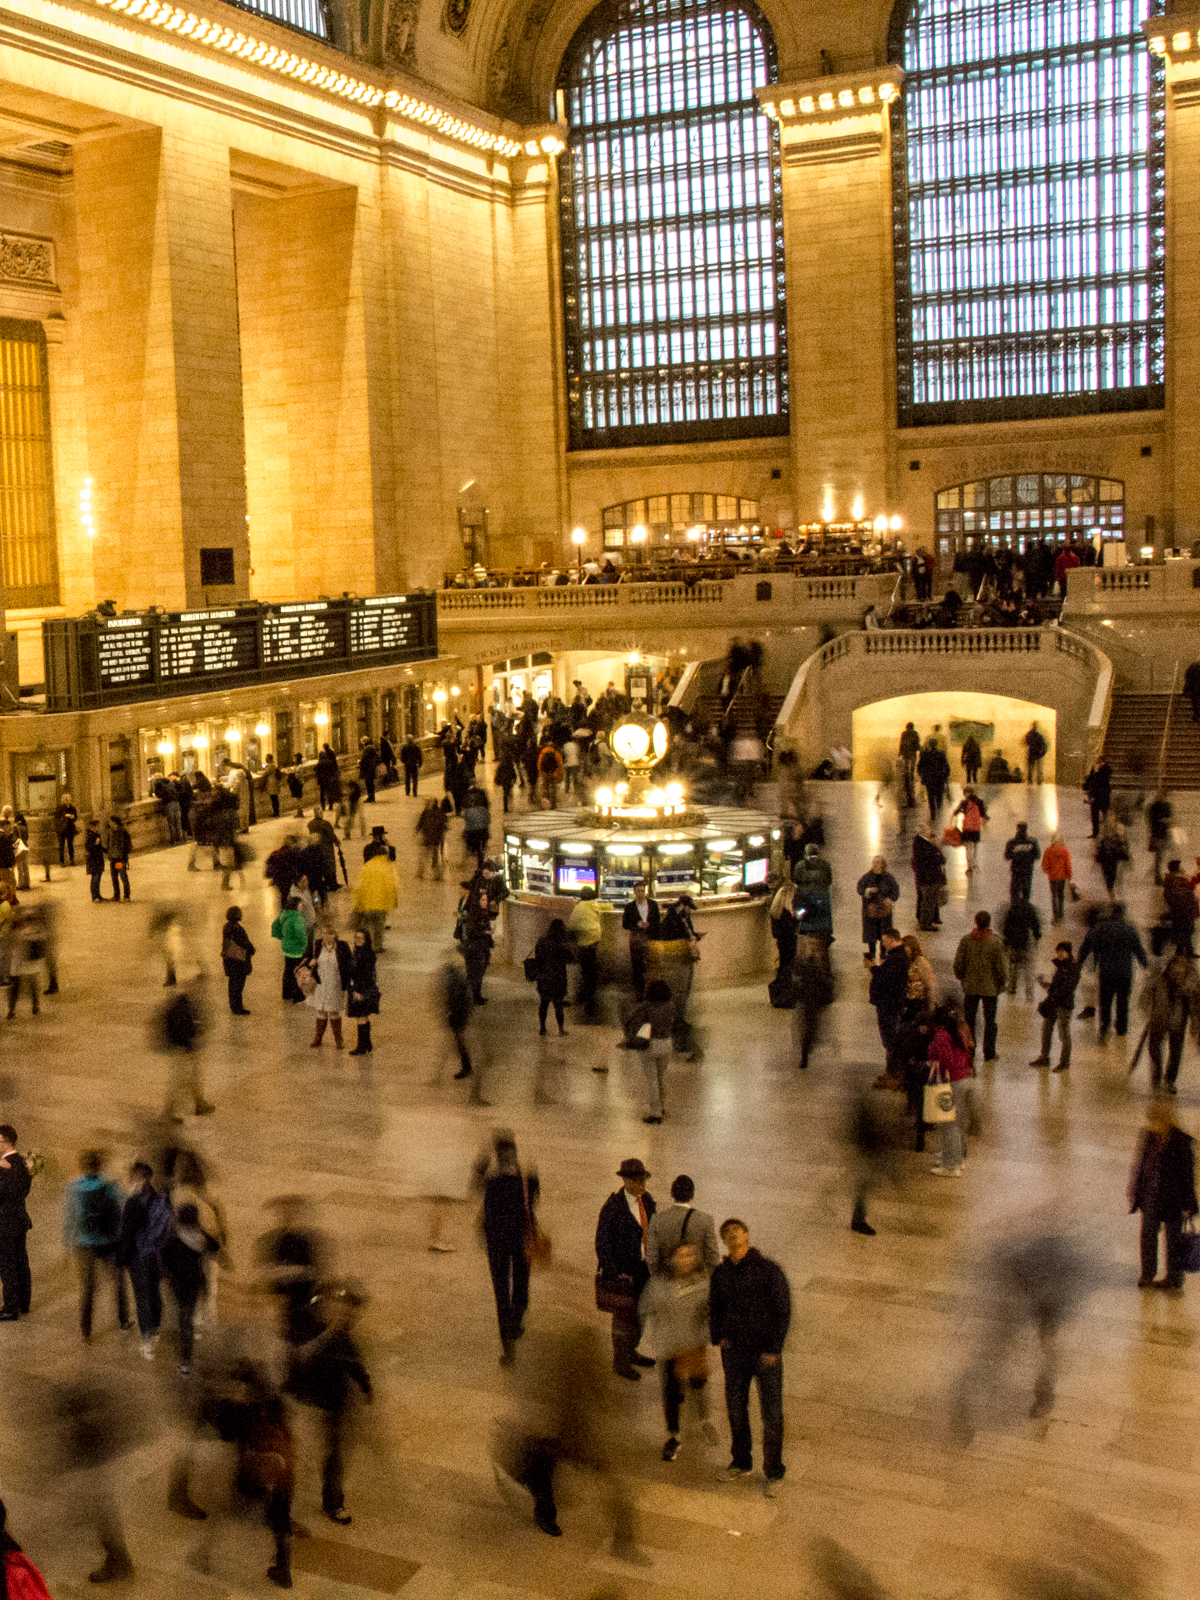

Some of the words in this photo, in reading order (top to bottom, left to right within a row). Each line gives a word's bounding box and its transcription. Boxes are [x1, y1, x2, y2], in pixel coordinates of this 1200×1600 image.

[181, 613, 200, 621] HARLEM
[210, 609, 237, 619] DEPARTURES
[108, 618, 142, 628] INFORMATION
